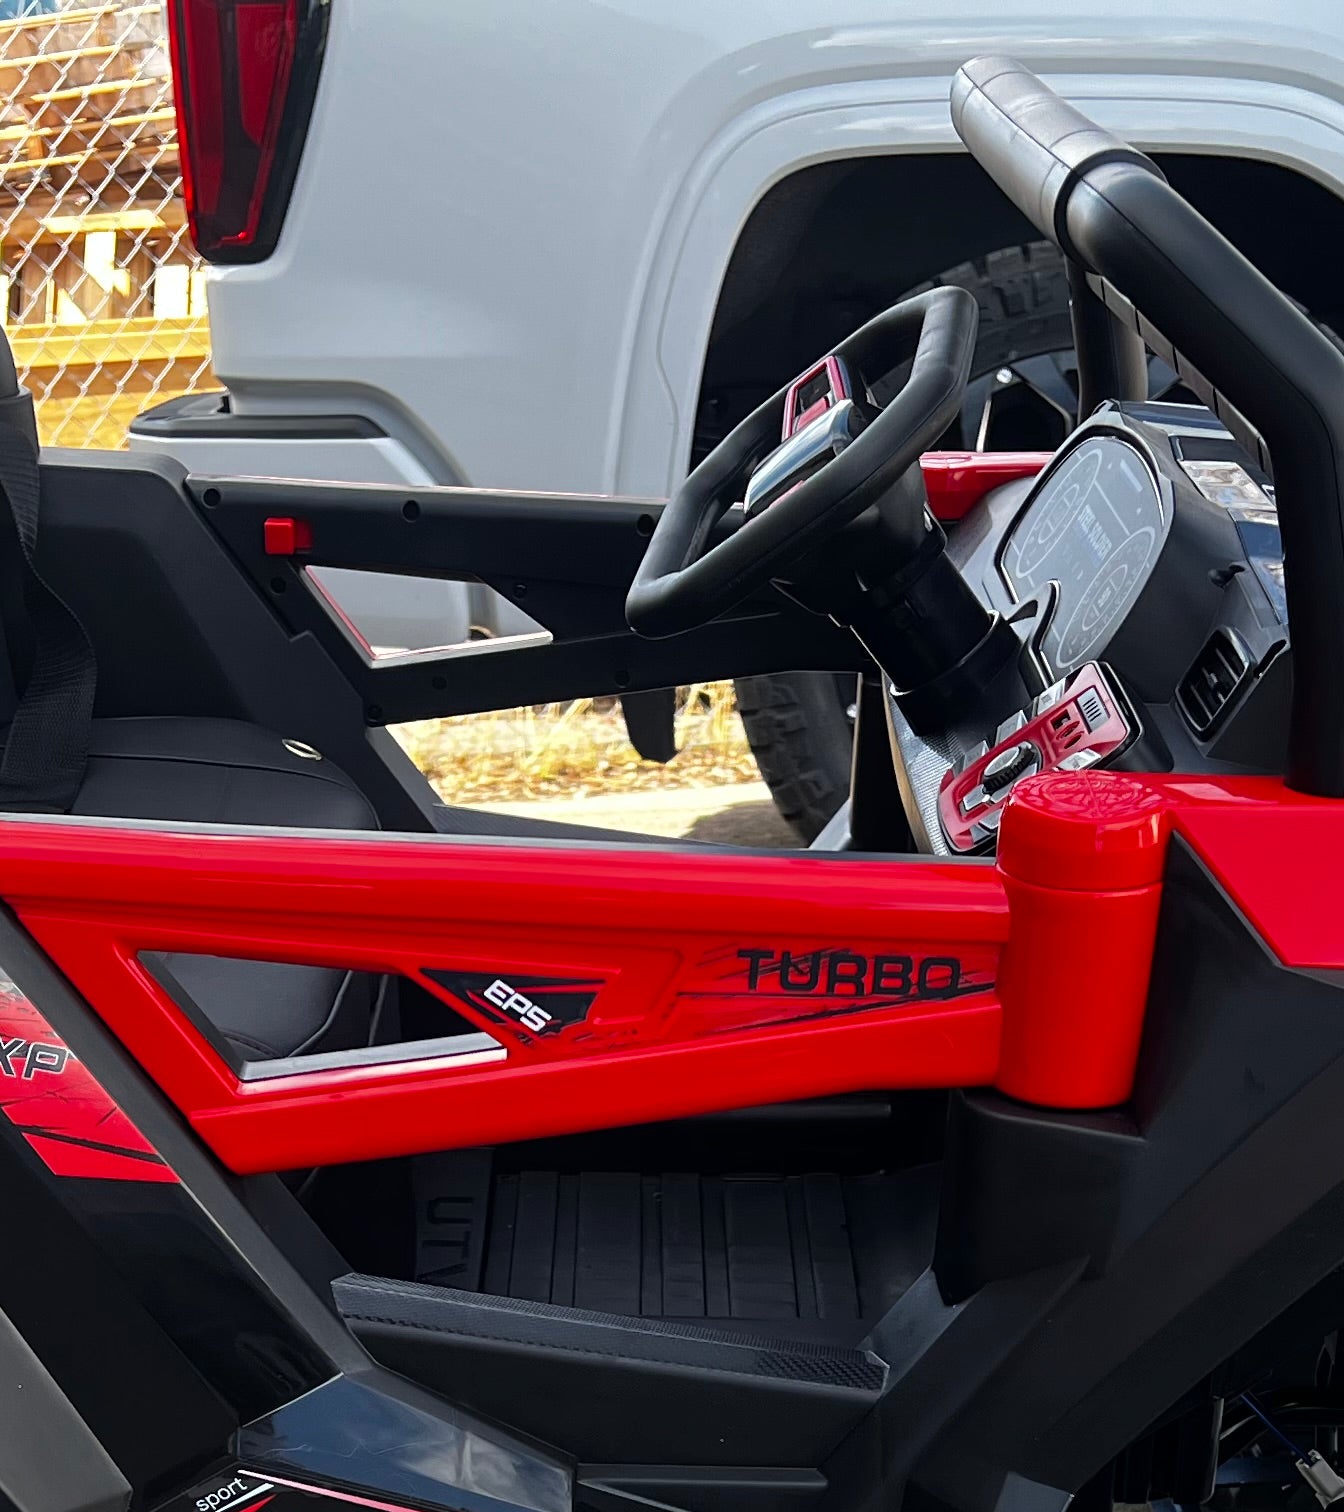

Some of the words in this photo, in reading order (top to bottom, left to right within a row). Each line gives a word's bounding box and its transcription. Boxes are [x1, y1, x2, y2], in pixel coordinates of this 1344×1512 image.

[737, 948, 961, 1001] TURBO
[483, 979, 552, 1032] EPS
[195, 1477, 249, 1512] sport
